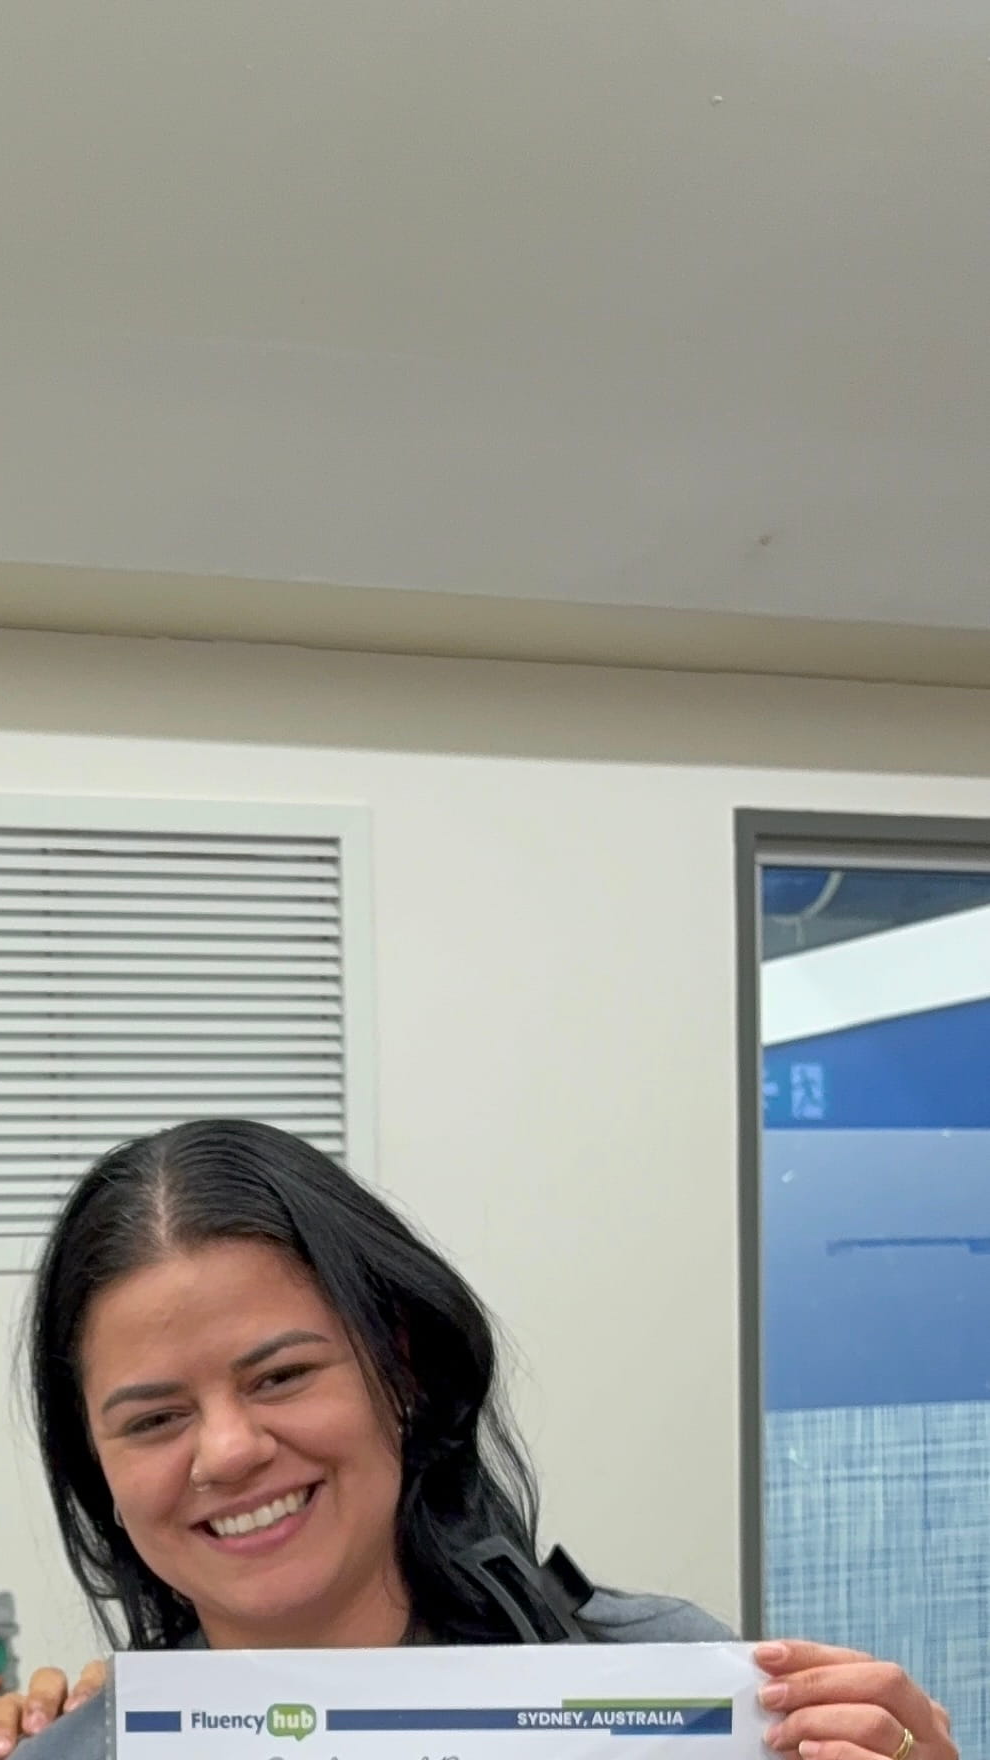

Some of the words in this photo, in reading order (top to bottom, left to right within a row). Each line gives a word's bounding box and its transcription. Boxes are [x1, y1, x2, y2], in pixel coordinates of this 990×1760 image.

[190, 1712, 265, 1735] Fluency
[272, 1710, 314, 1729] hub
[517, 1711, 588, 1728] SYDNEY,
[591, 1710, 684, 1725] AUSTRALIA
